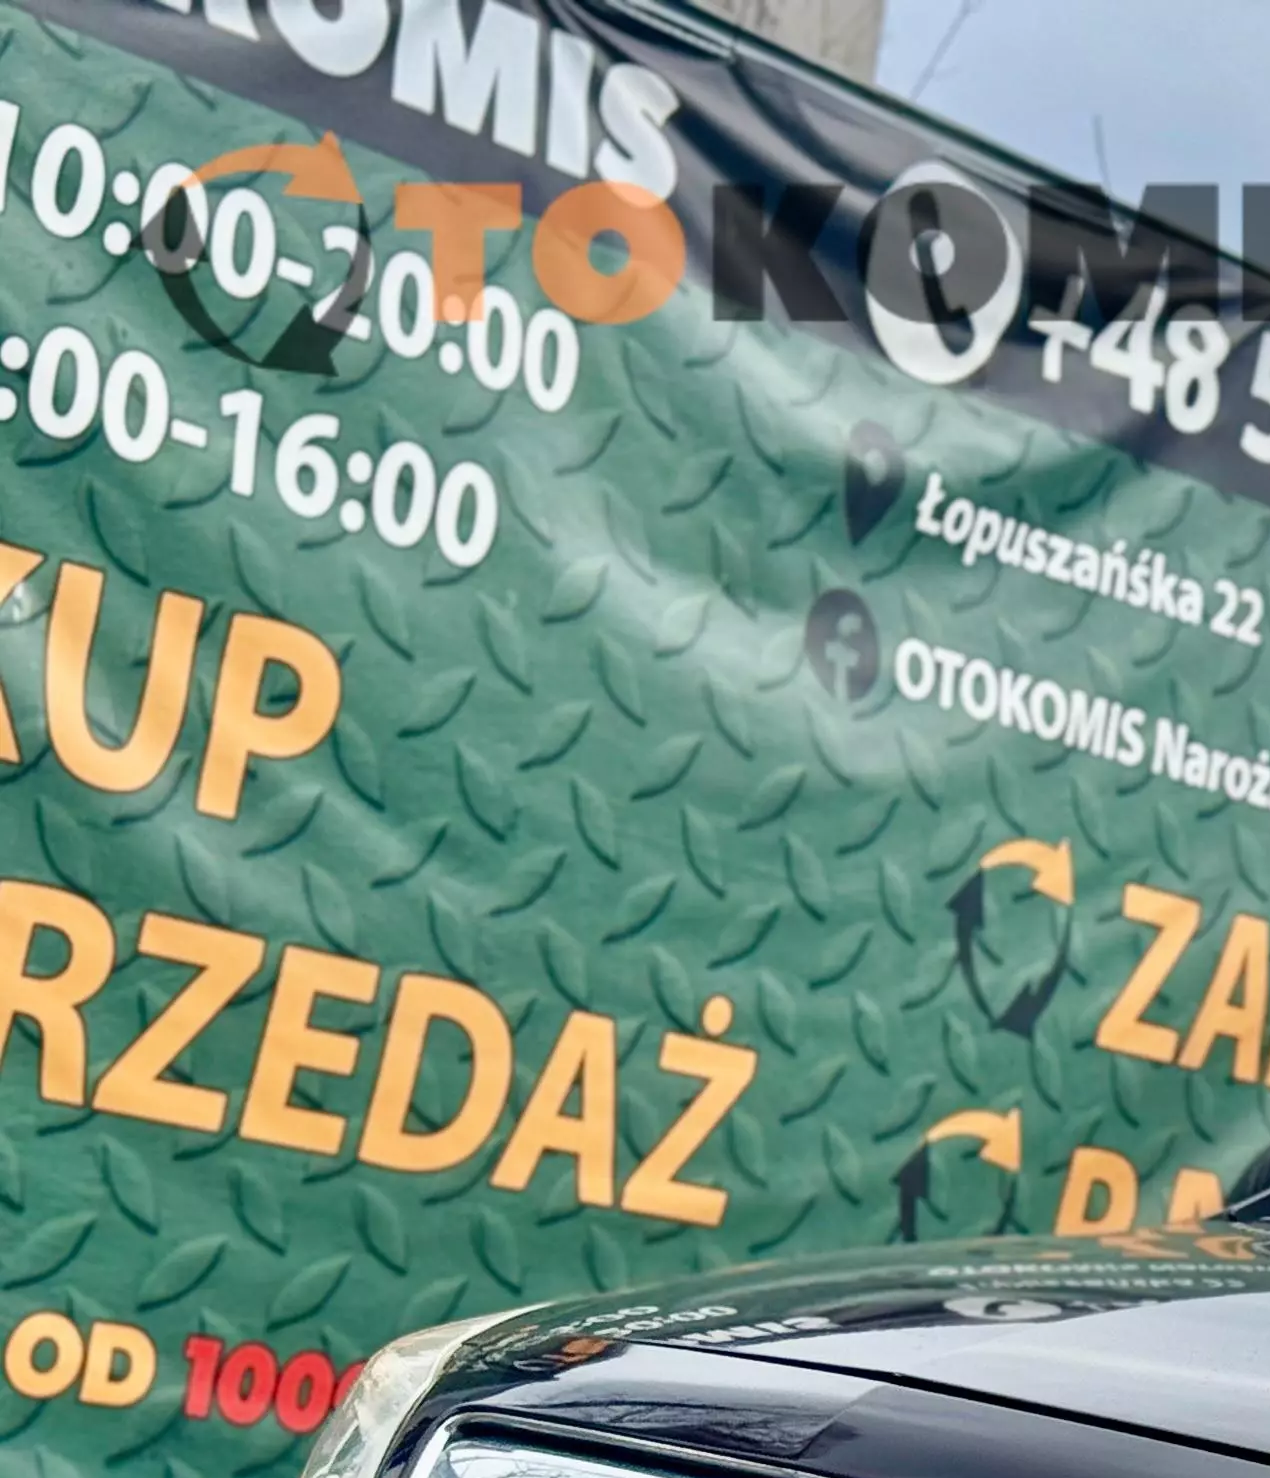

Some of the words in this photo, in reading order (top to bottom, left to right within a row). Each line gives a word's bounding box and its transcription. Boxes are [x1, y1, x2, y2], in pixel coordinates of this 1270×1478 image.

[1027, 272, 1230, 434] +48
[1209, 578, 1265, 647] 22
[895, 637, 1147, 767] OTOKOMIS
[0, 878, 758, 1228] RZEDAŻ
[4, 1311, 157, 1407] OD
[183, 1333, 367, 1435] 100
